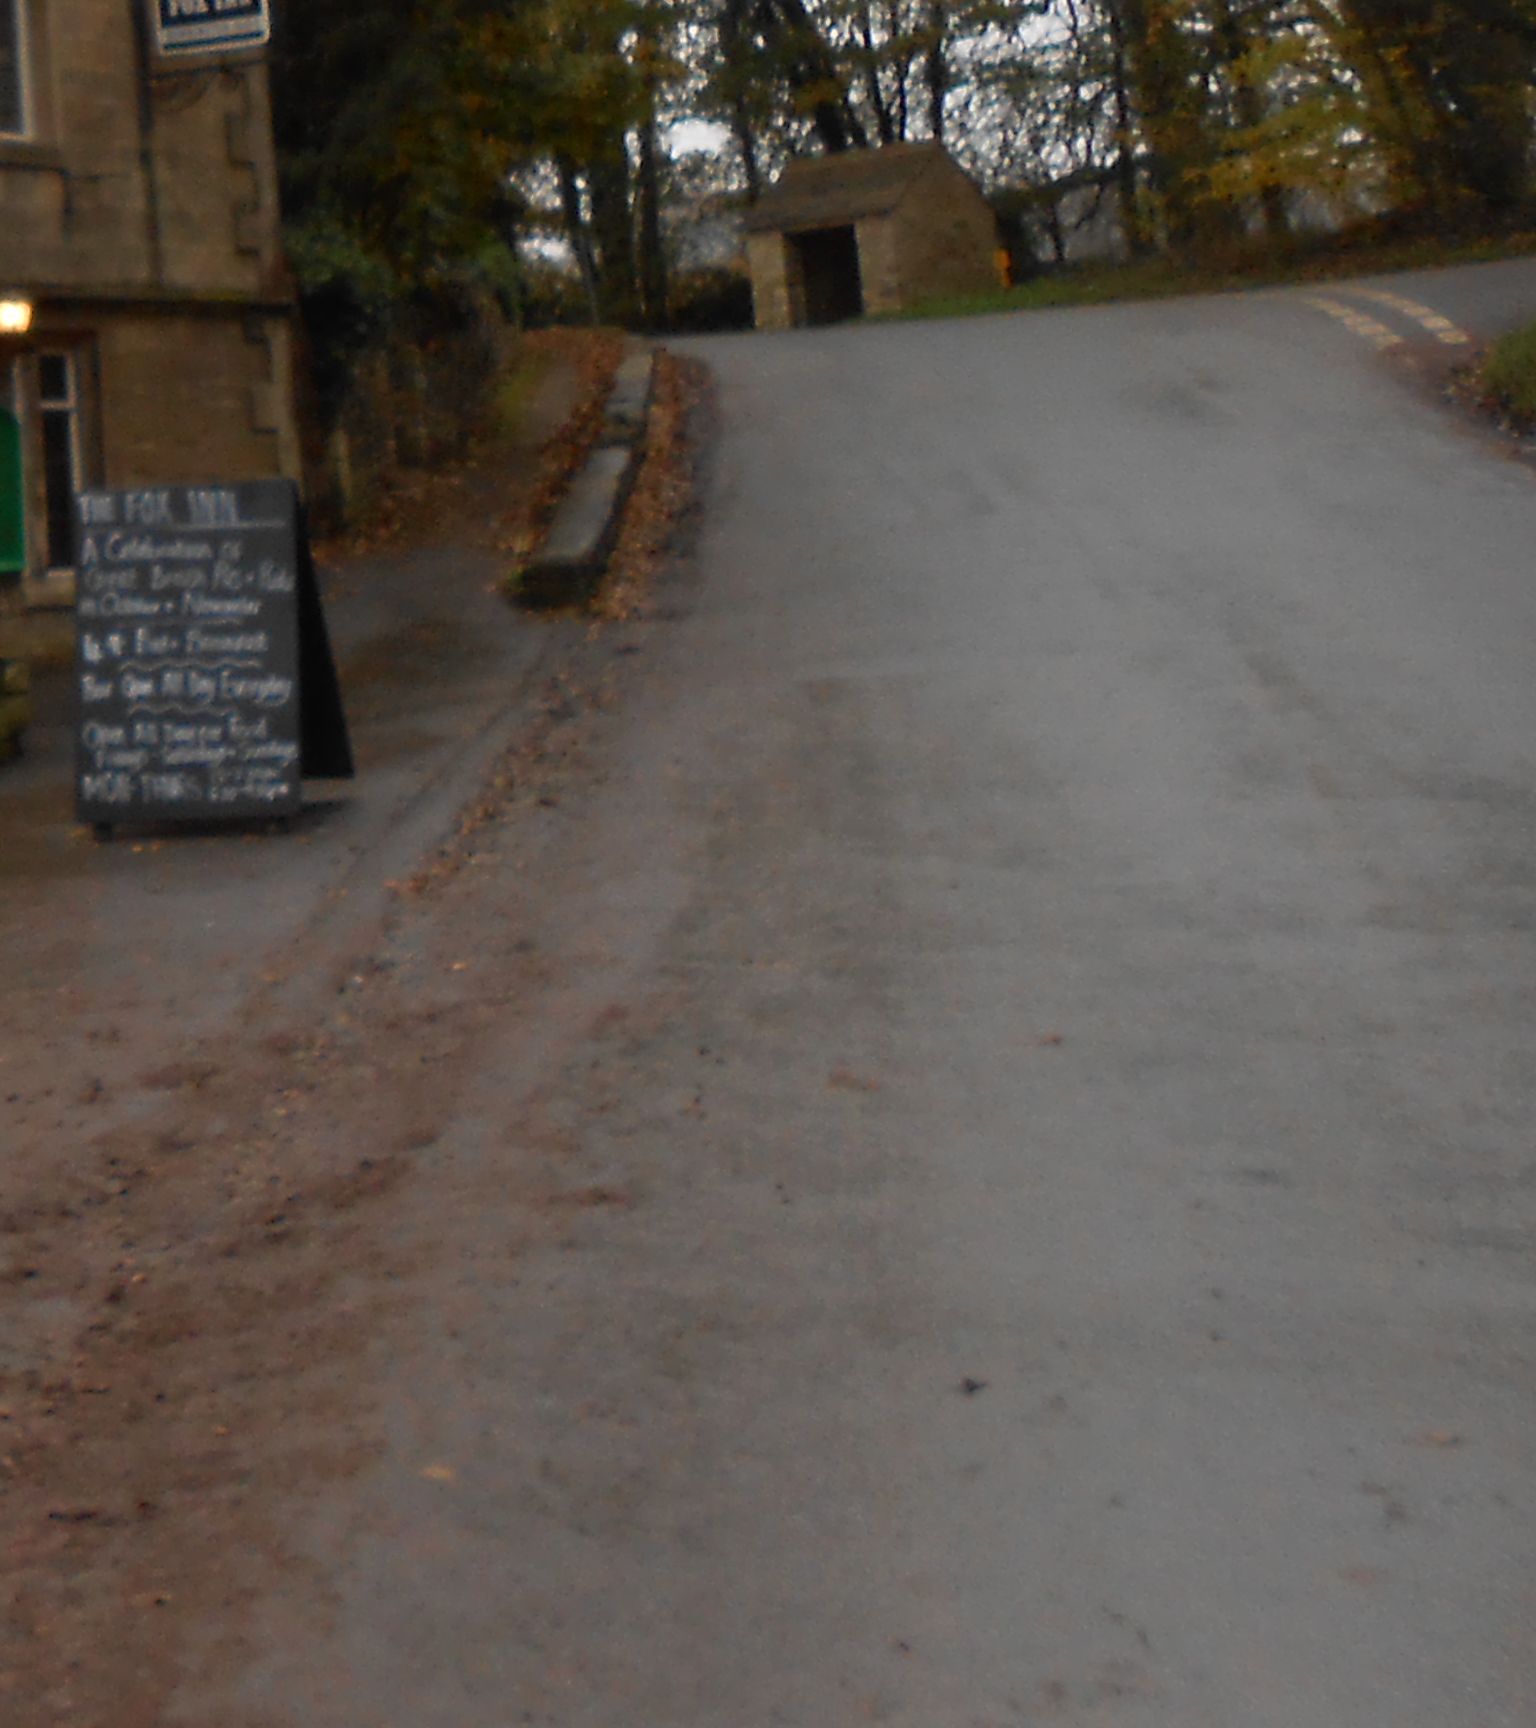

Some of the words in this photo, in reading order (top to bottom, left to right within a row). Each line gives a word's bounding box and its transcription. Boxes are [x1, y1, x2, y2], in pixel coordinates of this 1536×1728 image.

[78, 495, 116, 524] THE
[126, 491, 173, 524] FOX
[187, 489, 239, 525] INN
[82, 536, 99, 566] A
[104, 533, 213, 561] Celebration
[120, 673, 155, 700] Open
